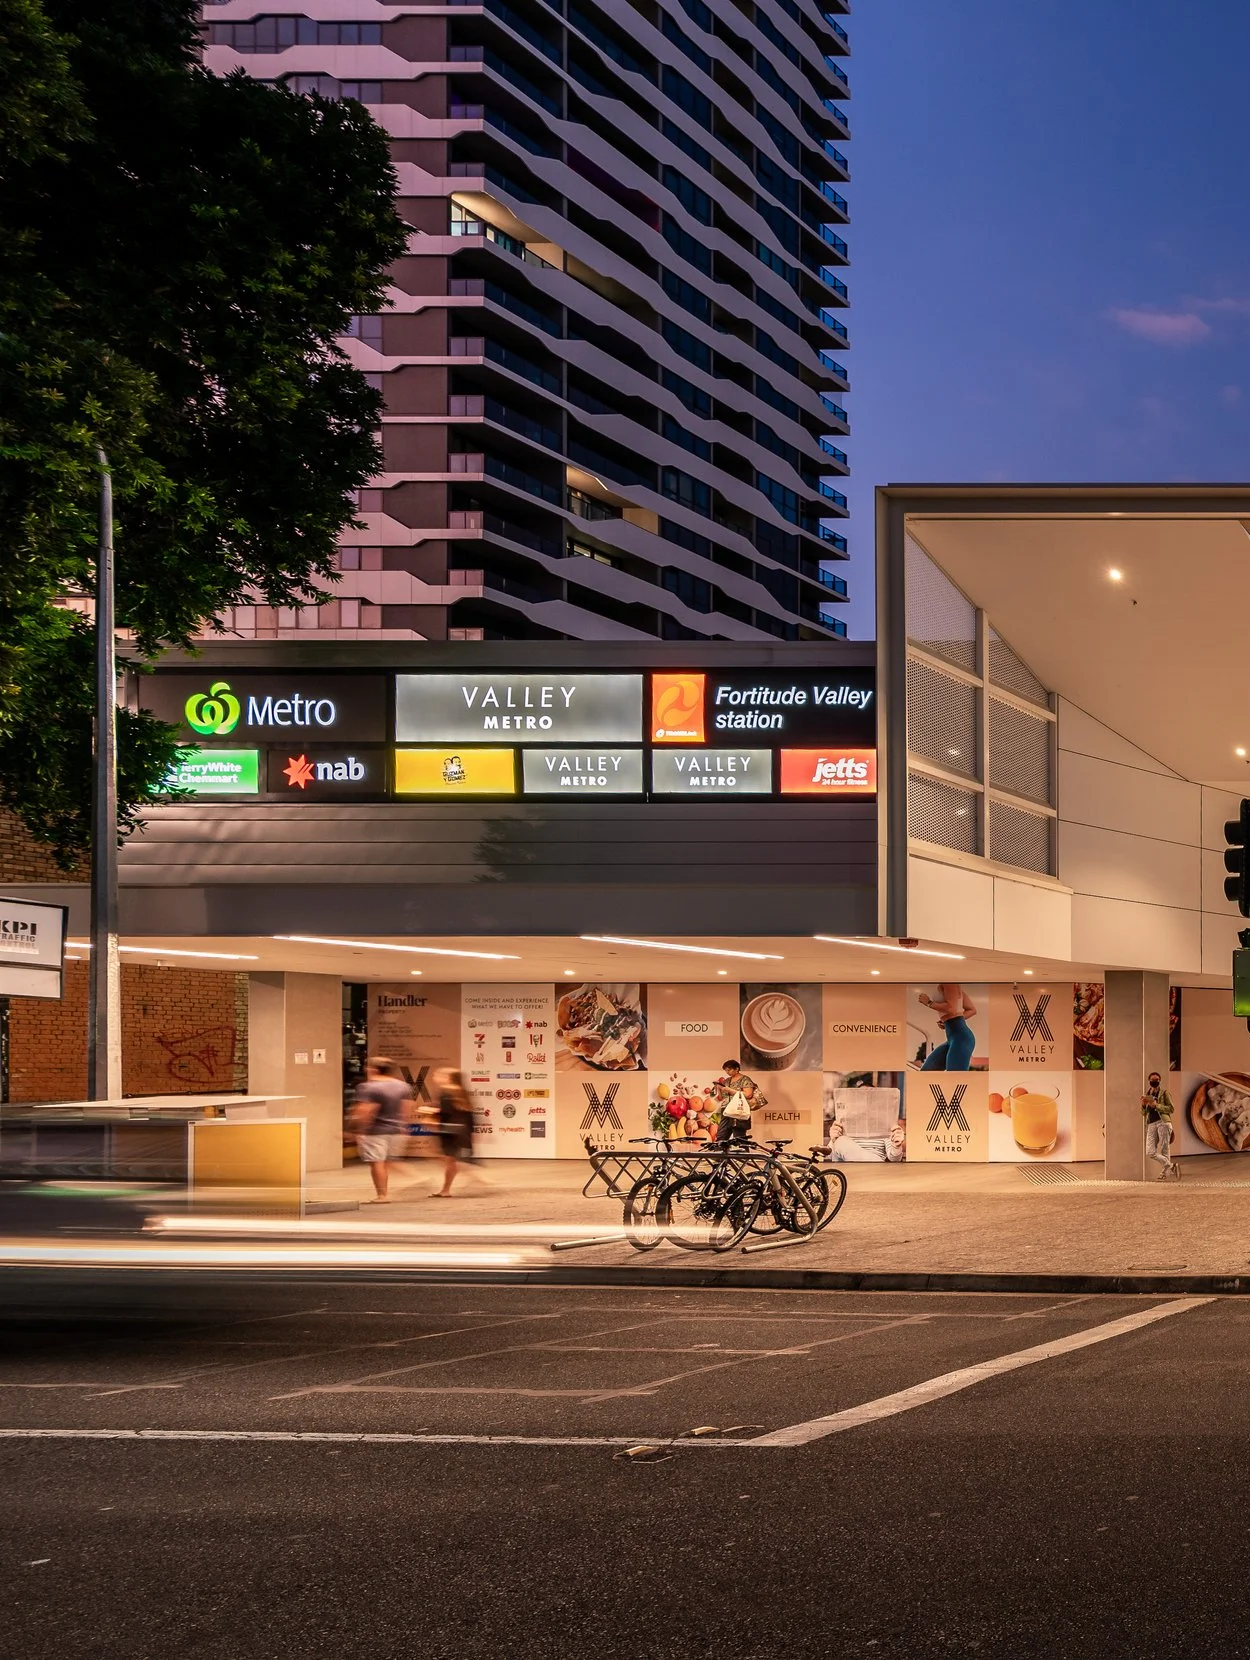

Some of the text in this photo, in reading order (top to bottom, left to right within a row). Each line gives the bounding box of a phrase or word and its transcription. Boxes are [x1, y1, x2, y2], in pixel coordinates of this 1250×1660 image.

[462, 686, 577, 709] VALLEY
[715, 686, 872, 709] Fortitude Valley
[247, 693, 336, 726] Metro
[483, 715, 553, 730] METRO
[715, 711, 783, 729] station
[316, 757, 366, 781] nab
[544, 756, 623, 773] VALLEY
[674, 756, 752, 772] VALLEY
[812, 758, 868, 782] jetts
[560, 776, 607, 787] METRO
[689, 776, 737, 787] METRO
[377, 995, 428, 1007] Handler
[680, 1023, 709, 1033] FOOD
[832, 1024, 898, 1034] CONVENIENCE
[1009, 1044, 1055, 1055] VALLEY
[528, 1107, 546, 1115] jetts
[764, 1112, 801, 1121] HEALTH
[579, 1133, 624, 1142] VALLEY
[925, 1134, 971, 1144] VALLEY
